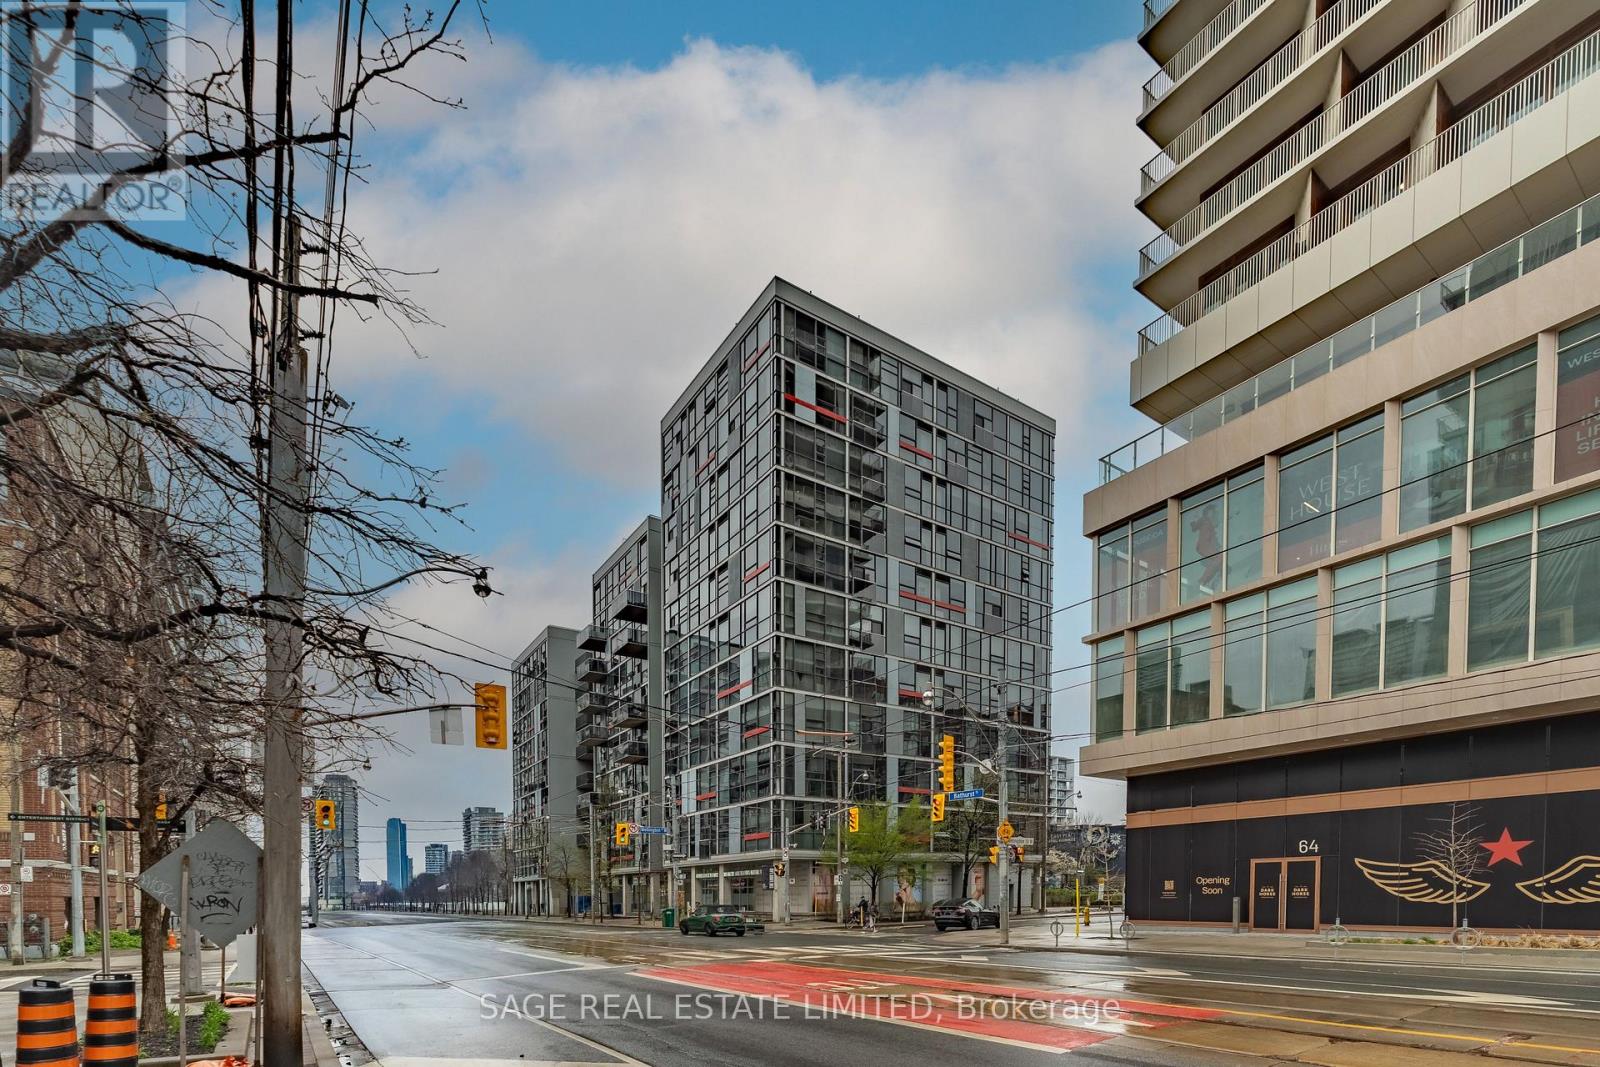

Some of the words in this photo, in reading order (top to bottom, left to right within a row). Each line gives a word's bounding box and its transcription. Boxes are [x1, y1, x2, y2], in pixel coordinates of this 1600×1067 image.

[1299, 462, 1363, 499] WEST
[1290, 476, 1372, 521] HOUSE
[1299, 840, 1319, 853] 64
[1196, 876, 1230, 886] Opening
[1202, 886, 1223, 895] Soon
